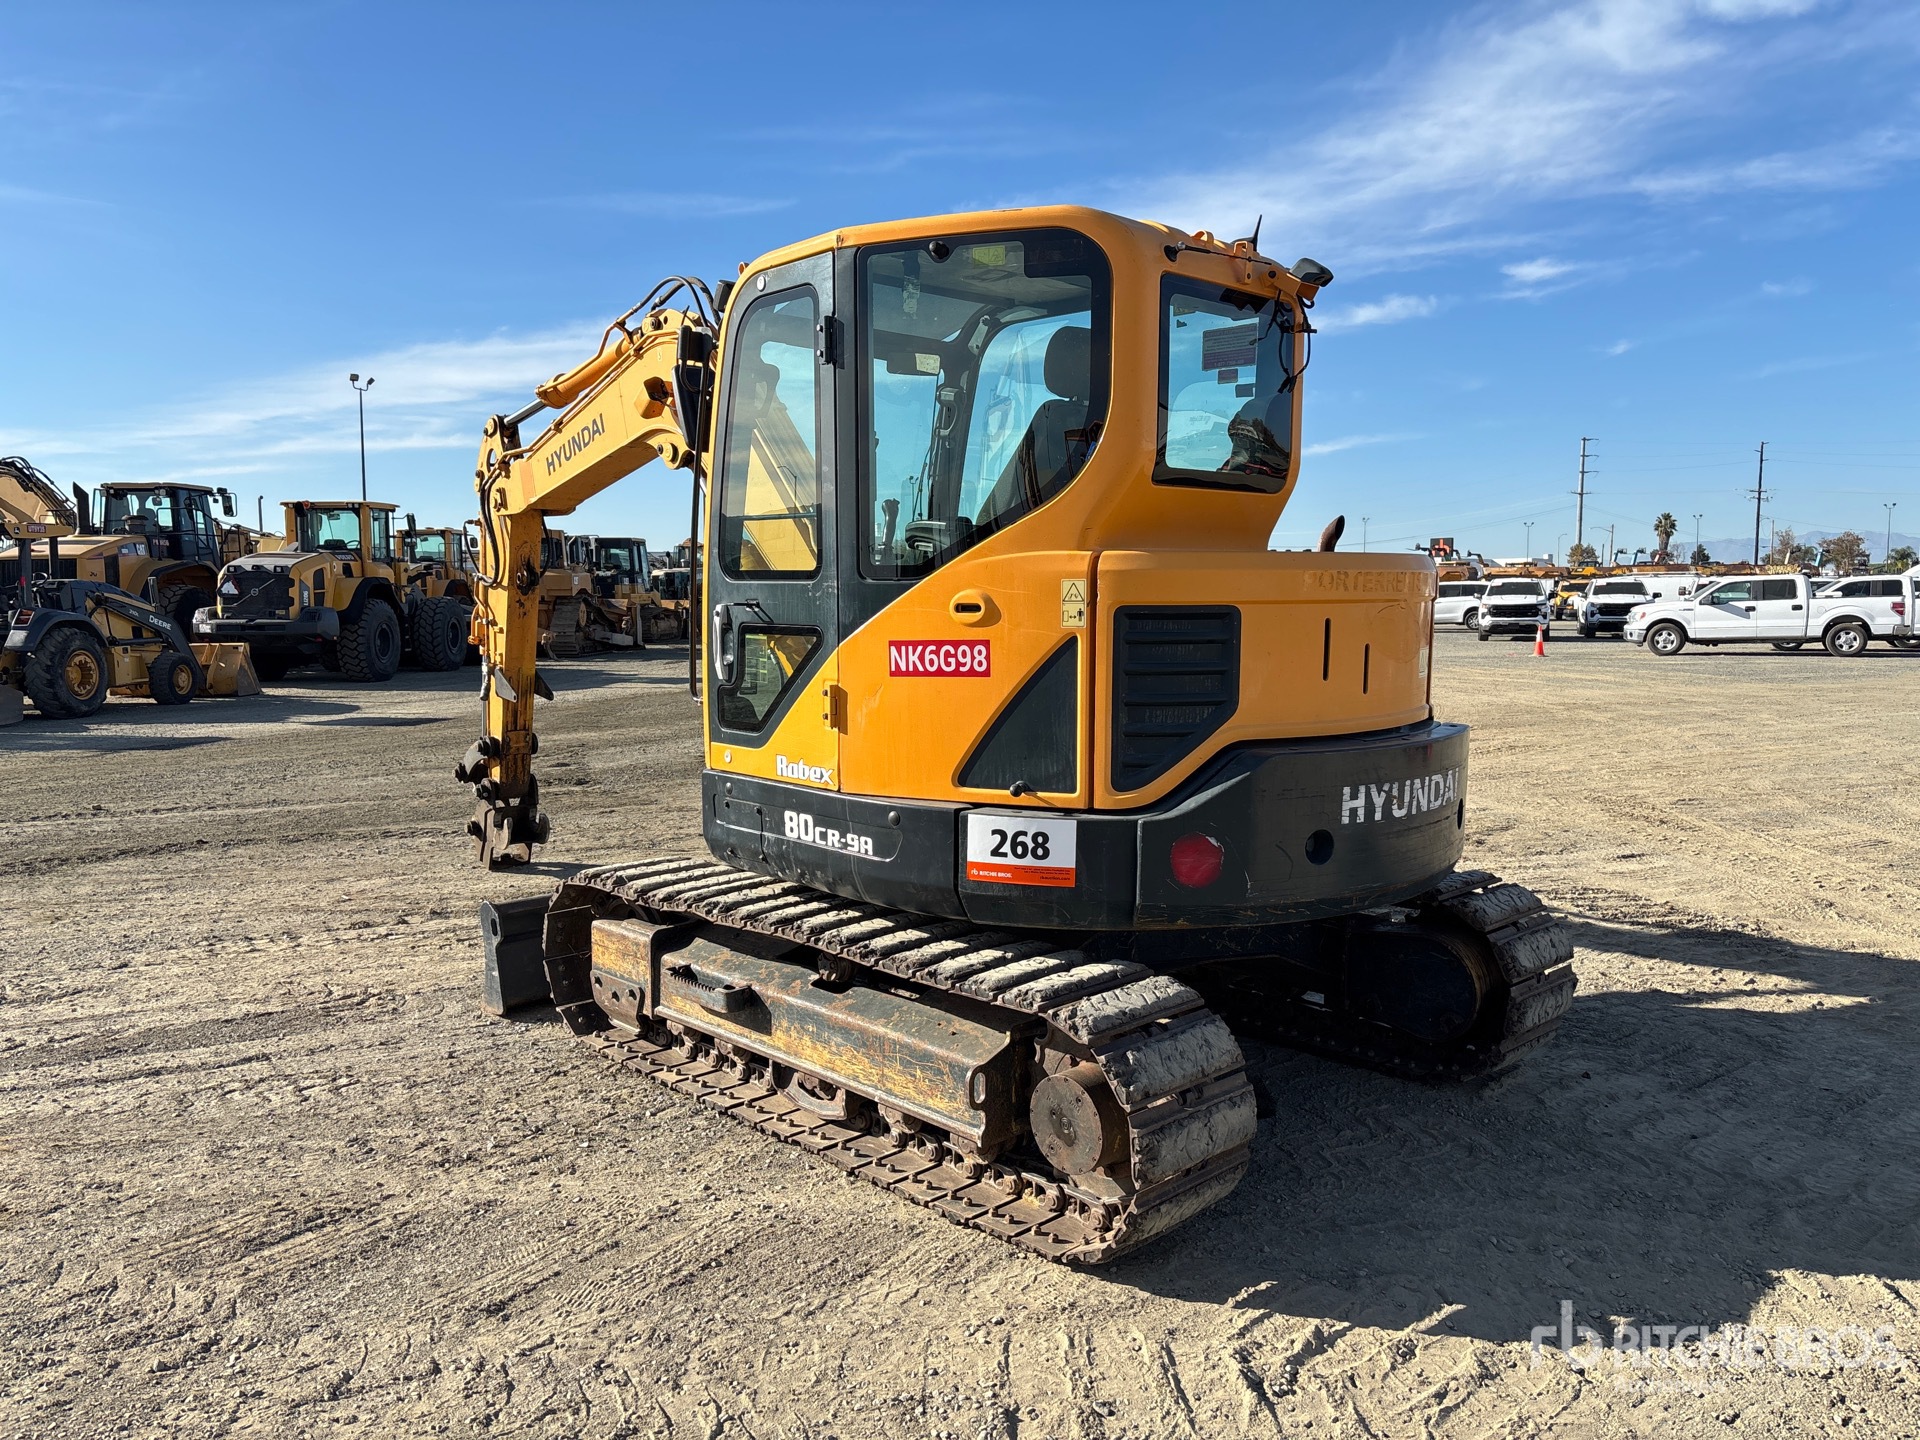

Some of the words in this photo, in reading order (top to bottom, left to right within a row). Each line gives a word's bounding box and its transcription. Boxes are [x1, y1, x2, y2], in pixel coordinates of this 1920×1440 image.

[546, 412, 605, 477] HYUNDAI
[149, 614, 172, 631] DEERE
[890, 644, 988, 673] NK6G98
[1341, 767, 1459, 825] HYUNDAI
[990, 828, 1050, 861] 268
